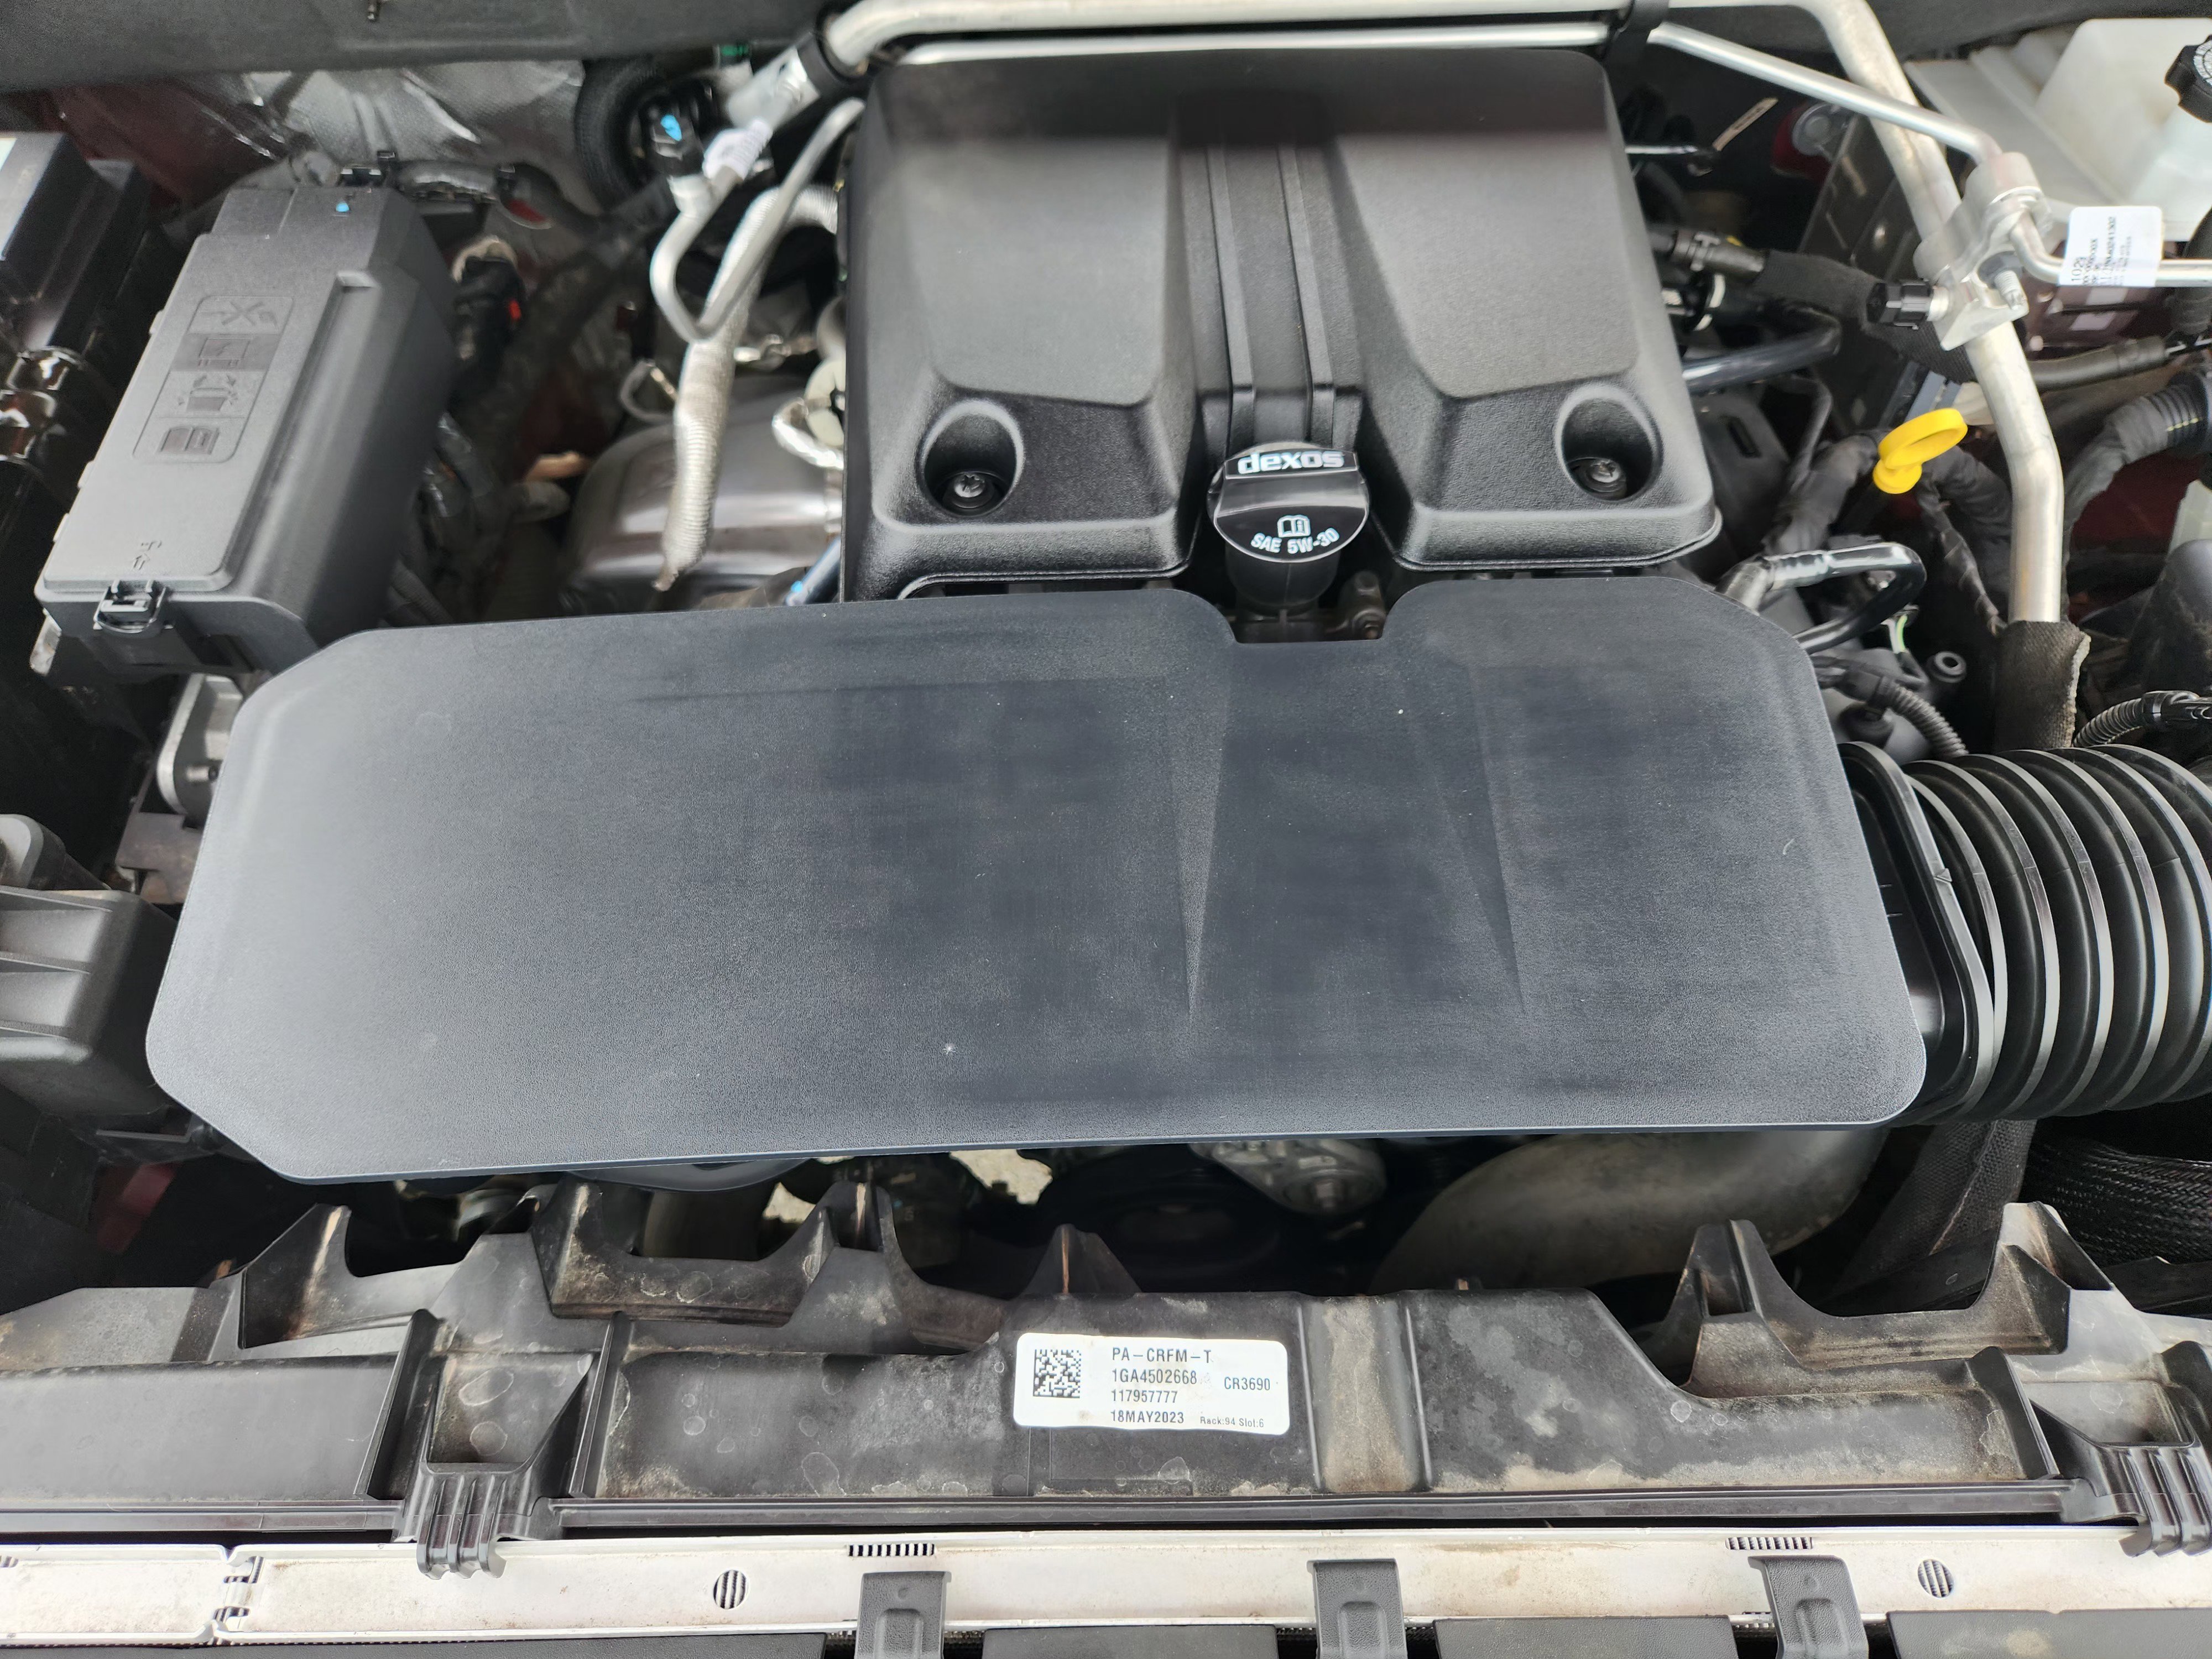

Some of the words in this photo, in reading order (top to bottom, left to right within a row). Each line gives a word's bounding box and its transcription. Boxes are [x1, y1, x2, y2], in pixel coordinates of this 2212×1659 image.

[1238, 450, 1344, 474] dexos
[1251, 533, 1282, 553] SAE
[1287, 528, 1340, 554] 5W-30
[1113, 1369, 1197, 1385] 1GA4502668
[1224, 1376, 1270, 1391] CR3690
[1112, 1389, 1177, 1403] 117957777
[1110, 1410, 1184, 1424] 18MAY2023
[1201, 1416, 1235, 1426] Rack:94
